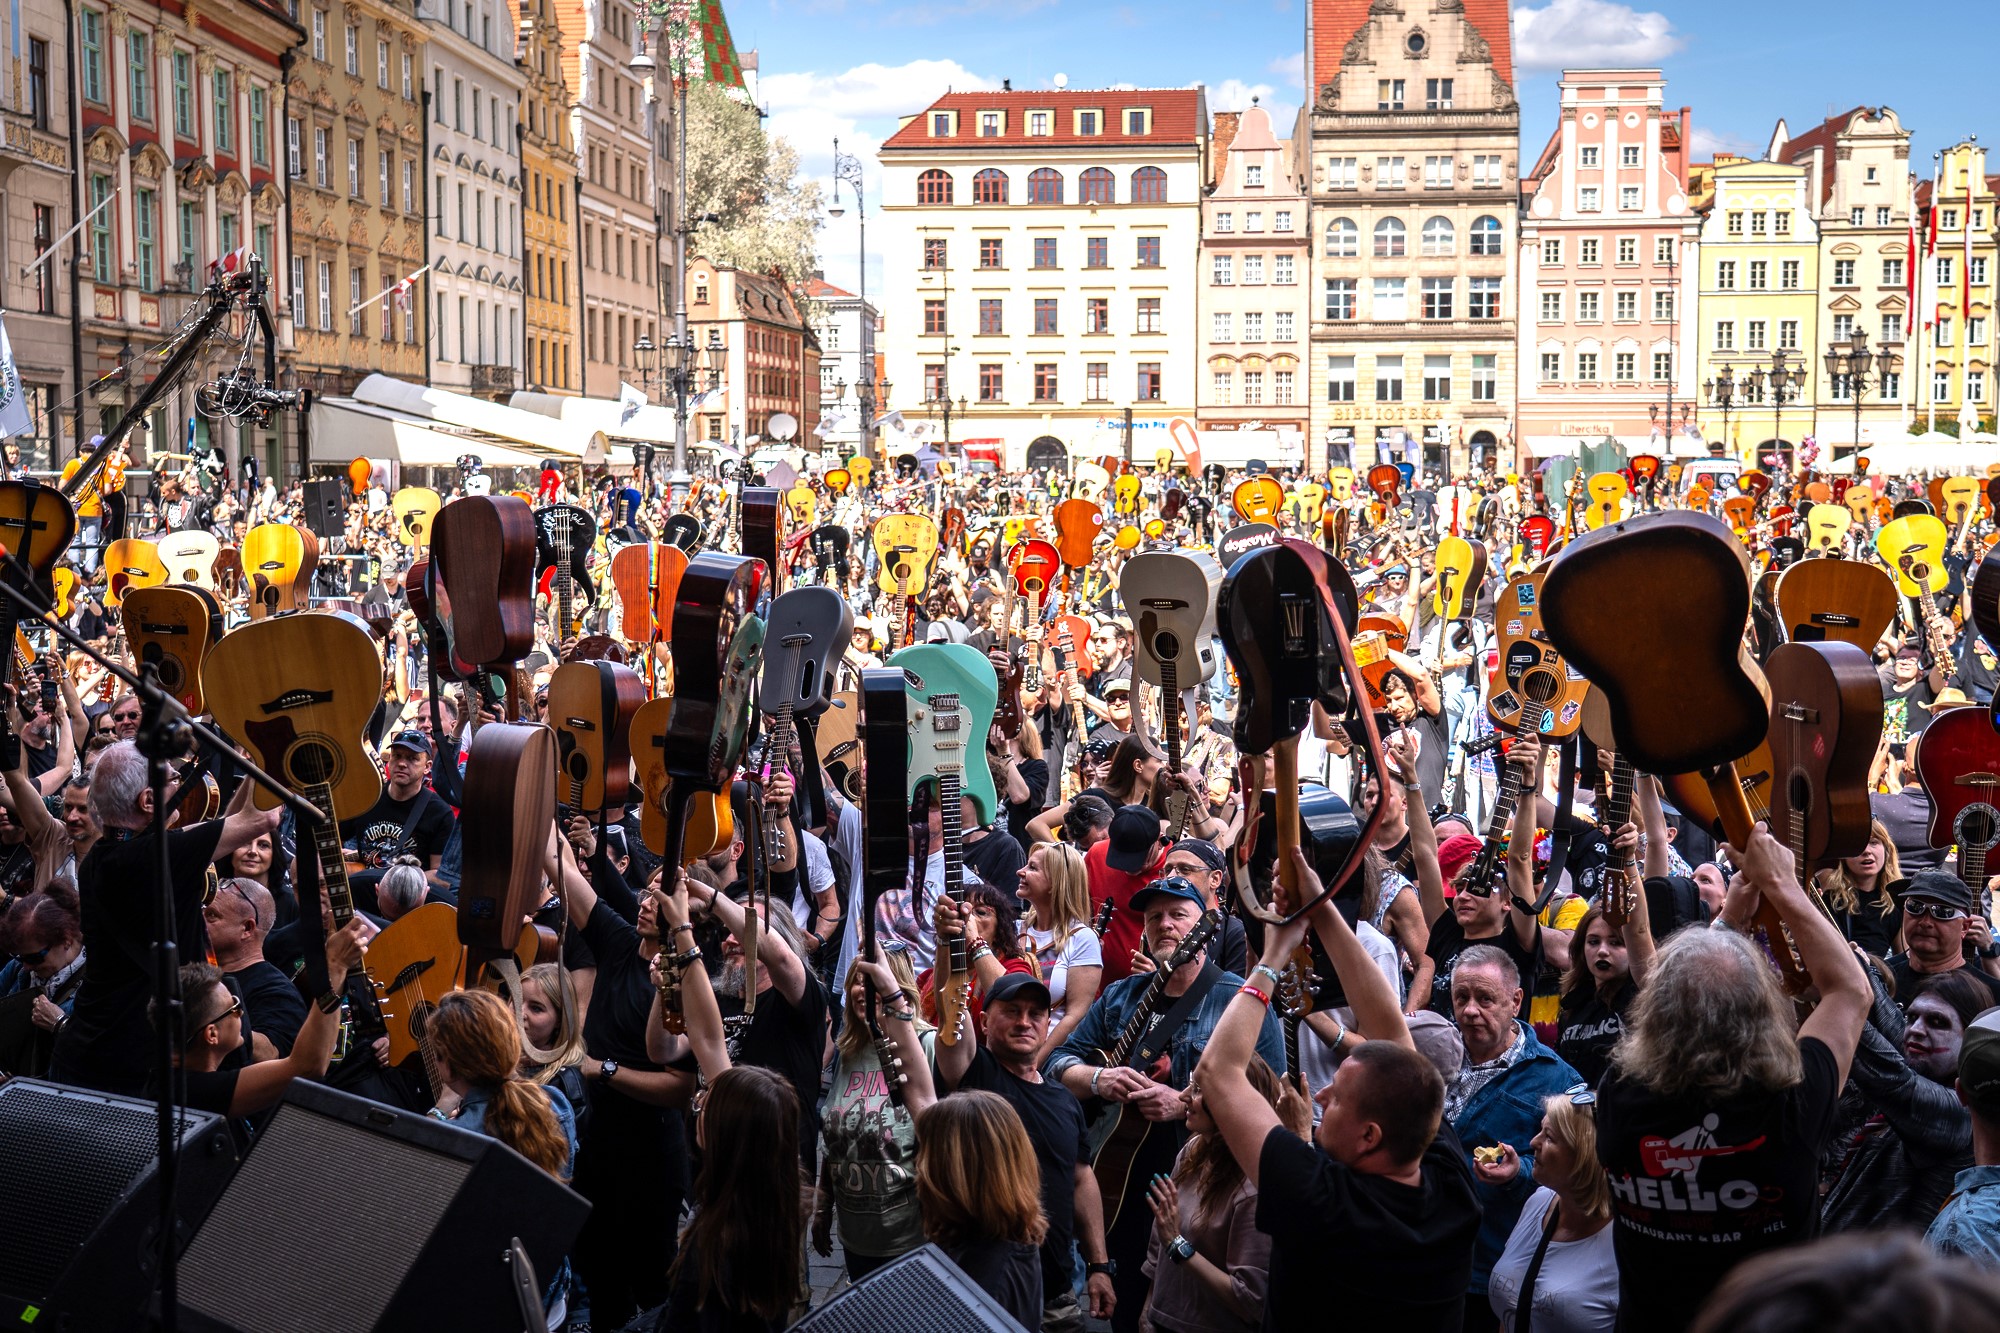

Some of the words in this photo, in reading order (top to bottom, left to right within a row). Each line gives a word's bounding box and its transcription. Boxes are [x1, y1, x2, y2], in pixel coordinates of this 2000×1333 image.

[1333, 408, 1443, 421] BIBLIOTEKA
[843, 1070, 890, 1098] PIN
[1609, 1173, 1759, 1212] HELLO
[1619, 1214, 1693, 1243] RESTAURANT
[1712, 1231, 1742, 1244] BAR
